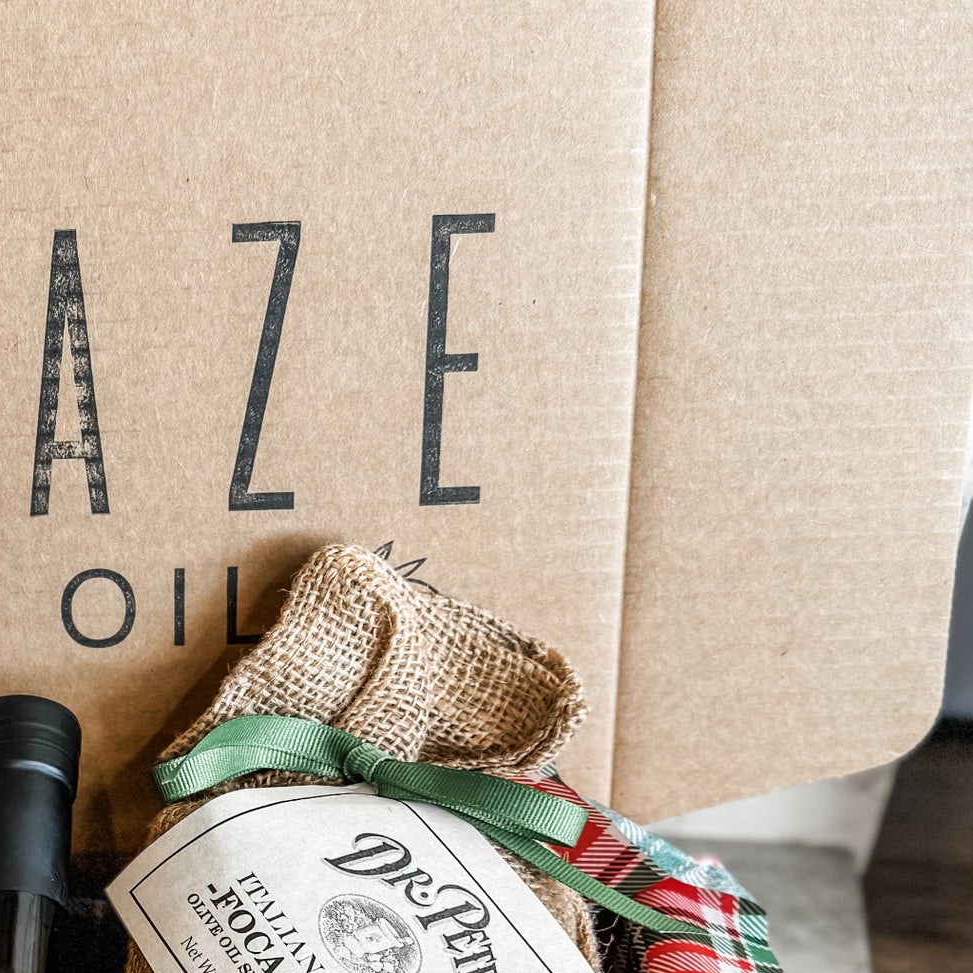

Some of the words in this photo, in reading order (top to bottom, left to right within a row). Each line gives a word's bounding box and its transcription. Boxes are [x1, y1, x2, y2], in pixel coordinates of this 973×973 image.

[61, 566, 263, 648] OIL
[180, 935, 203, 962] Net
[187, 893, 224, 937] OLIVE
[218, 935, 243, 965] OIL
